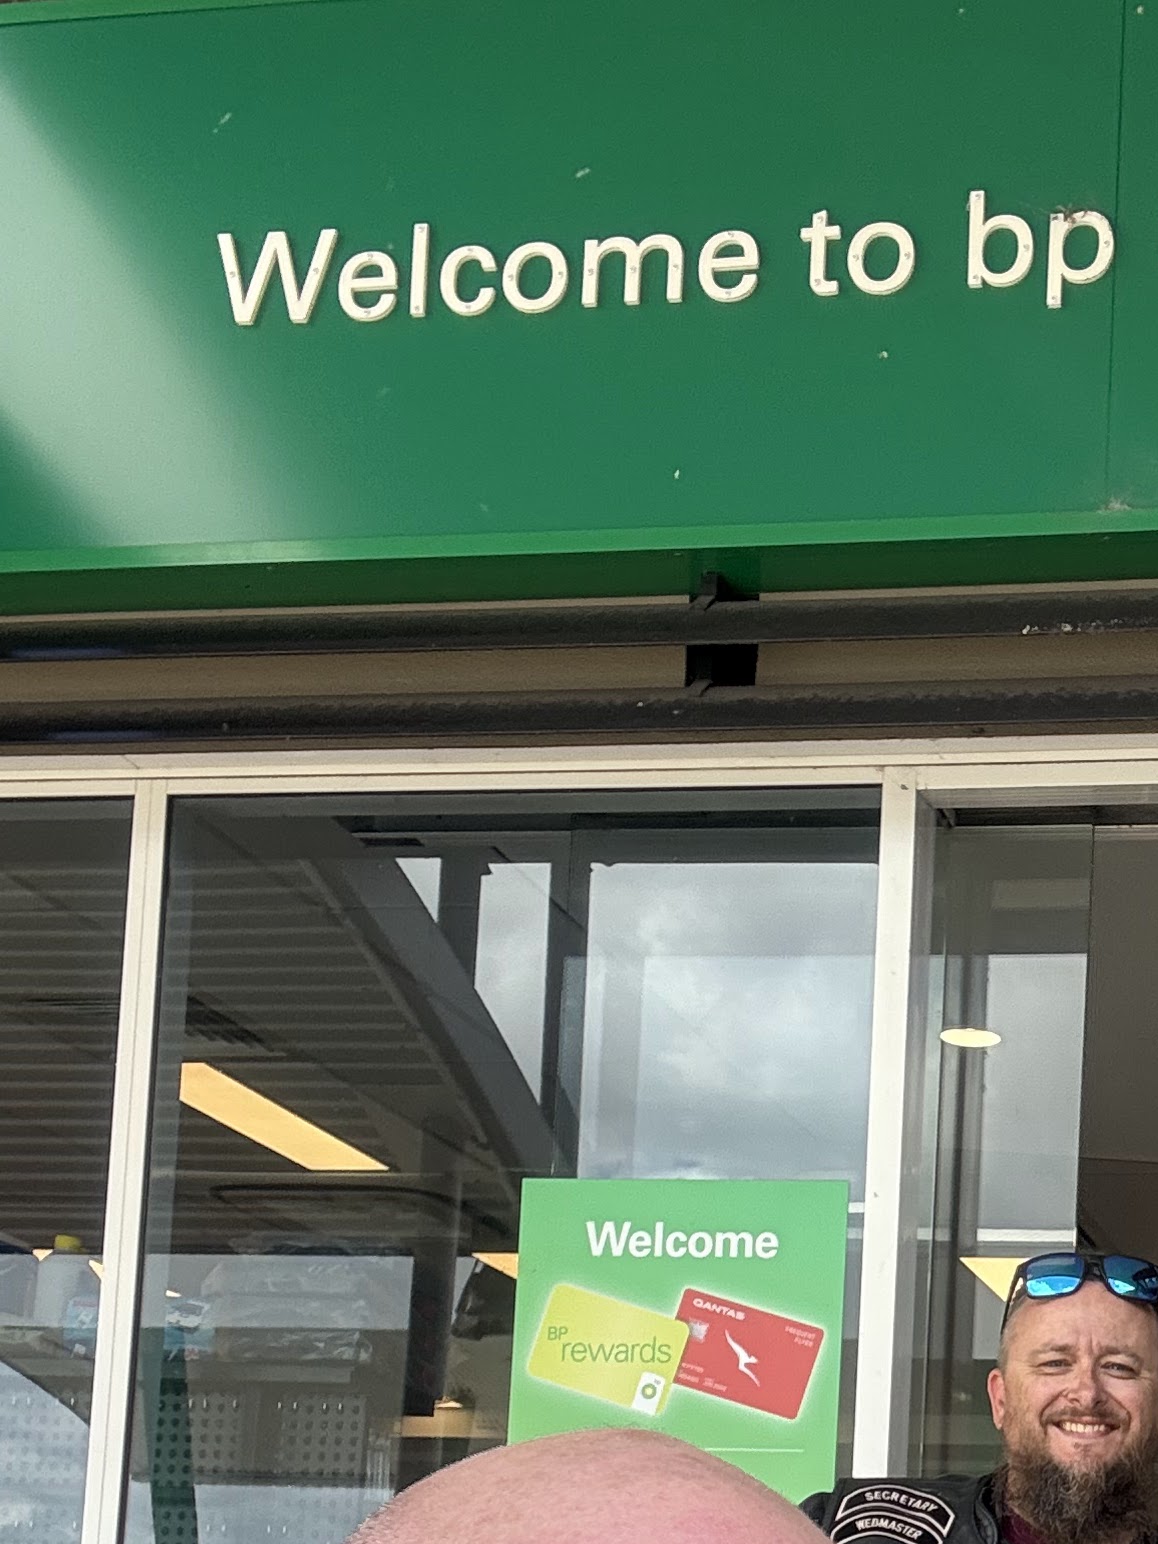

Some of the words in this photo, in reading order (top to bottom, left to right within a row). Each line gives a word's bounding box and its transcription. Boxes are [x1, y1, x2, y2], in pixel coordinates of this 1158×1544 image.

[216, 223, 759, 325] Welcome
[800, 208, 915, 297] to
[966, 190, 1115, 308] bp
[585, 1221, 779, 1259] Welcome
[547, 1326, 568, 1341] BP
[561, 1335, 672, 1364] rewards
[864, 1490, 938, 1512] SECRETARY
